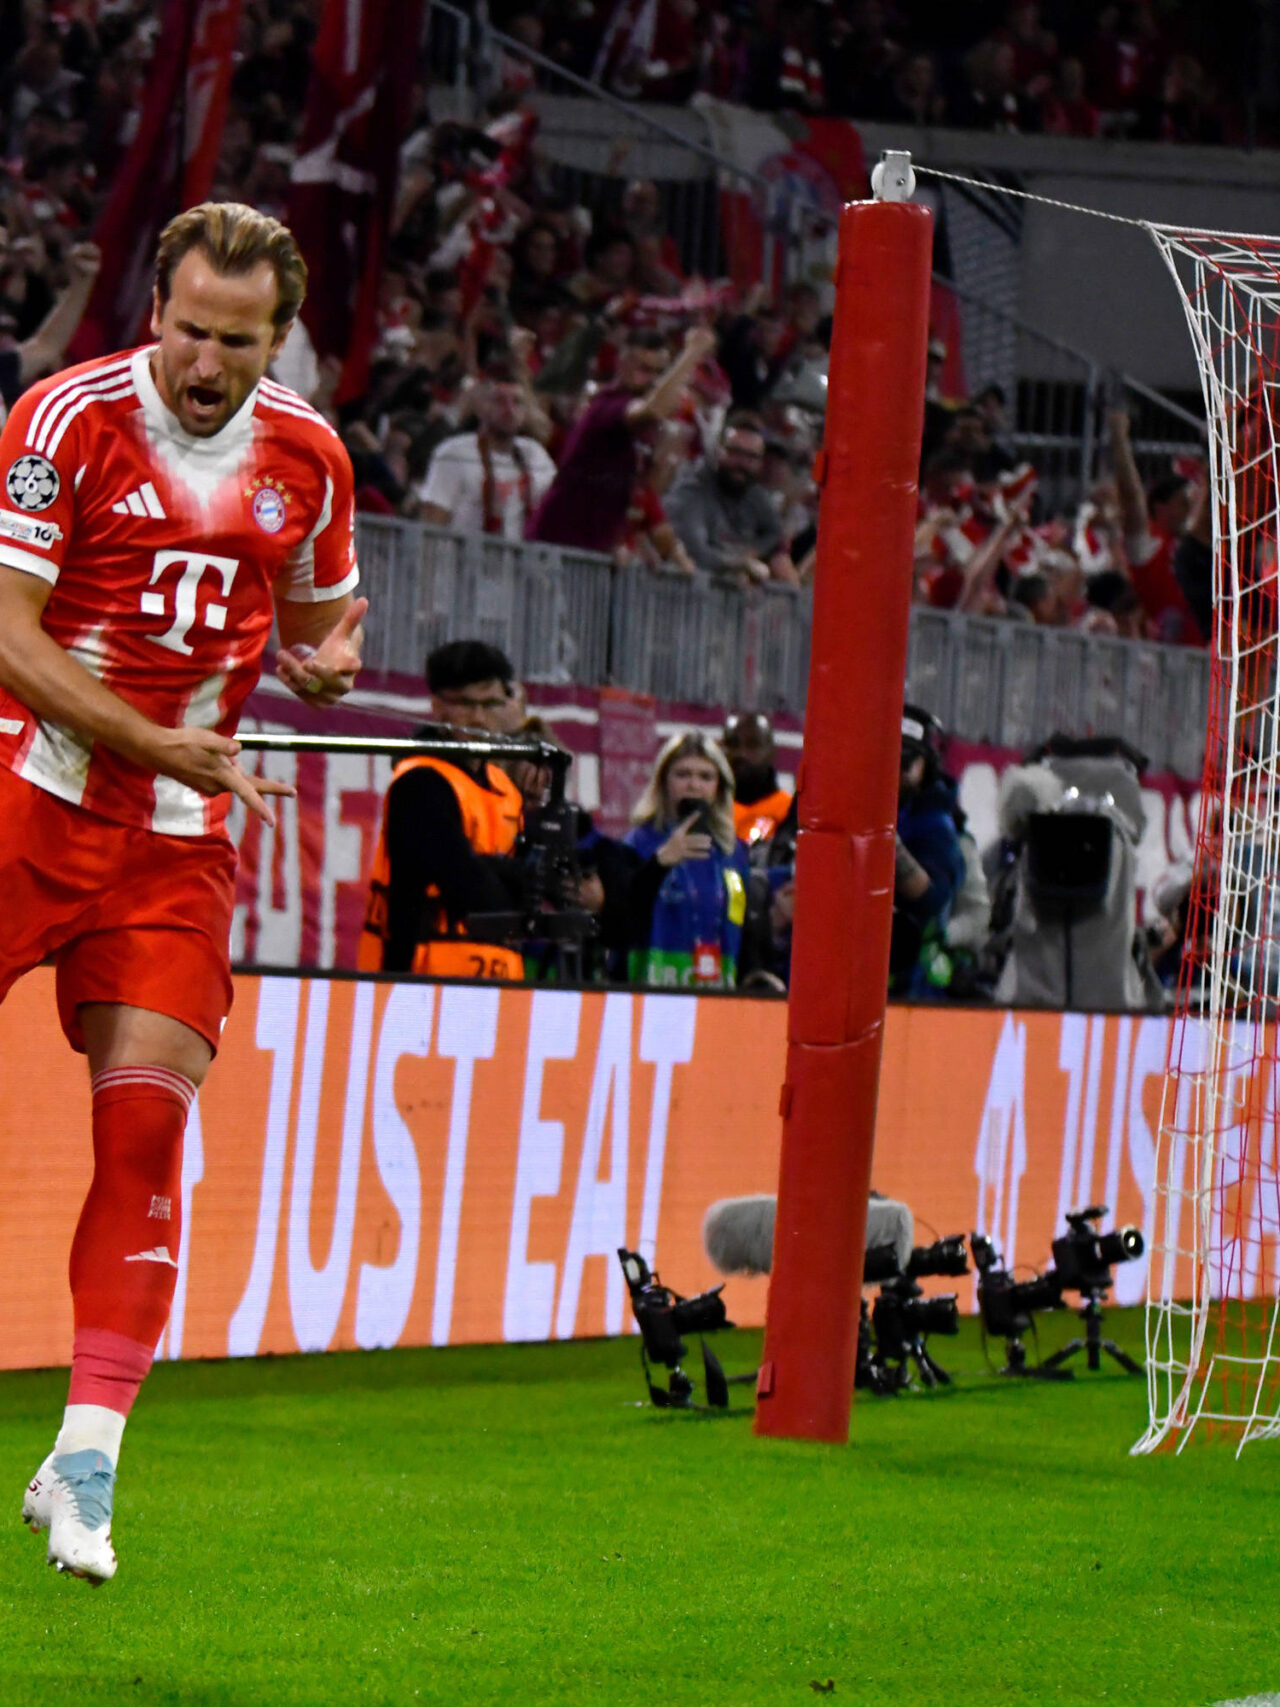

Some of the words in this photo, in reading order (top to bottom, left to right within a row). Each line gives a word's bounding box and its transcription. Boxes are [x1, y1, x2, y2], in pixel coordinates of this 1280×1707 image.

[24, 472, 39, 494] 6
[140, 549, 240, 656] T
[227, 975, 500, 1357] JUST
[502, 989, 696, 1342] EAT
